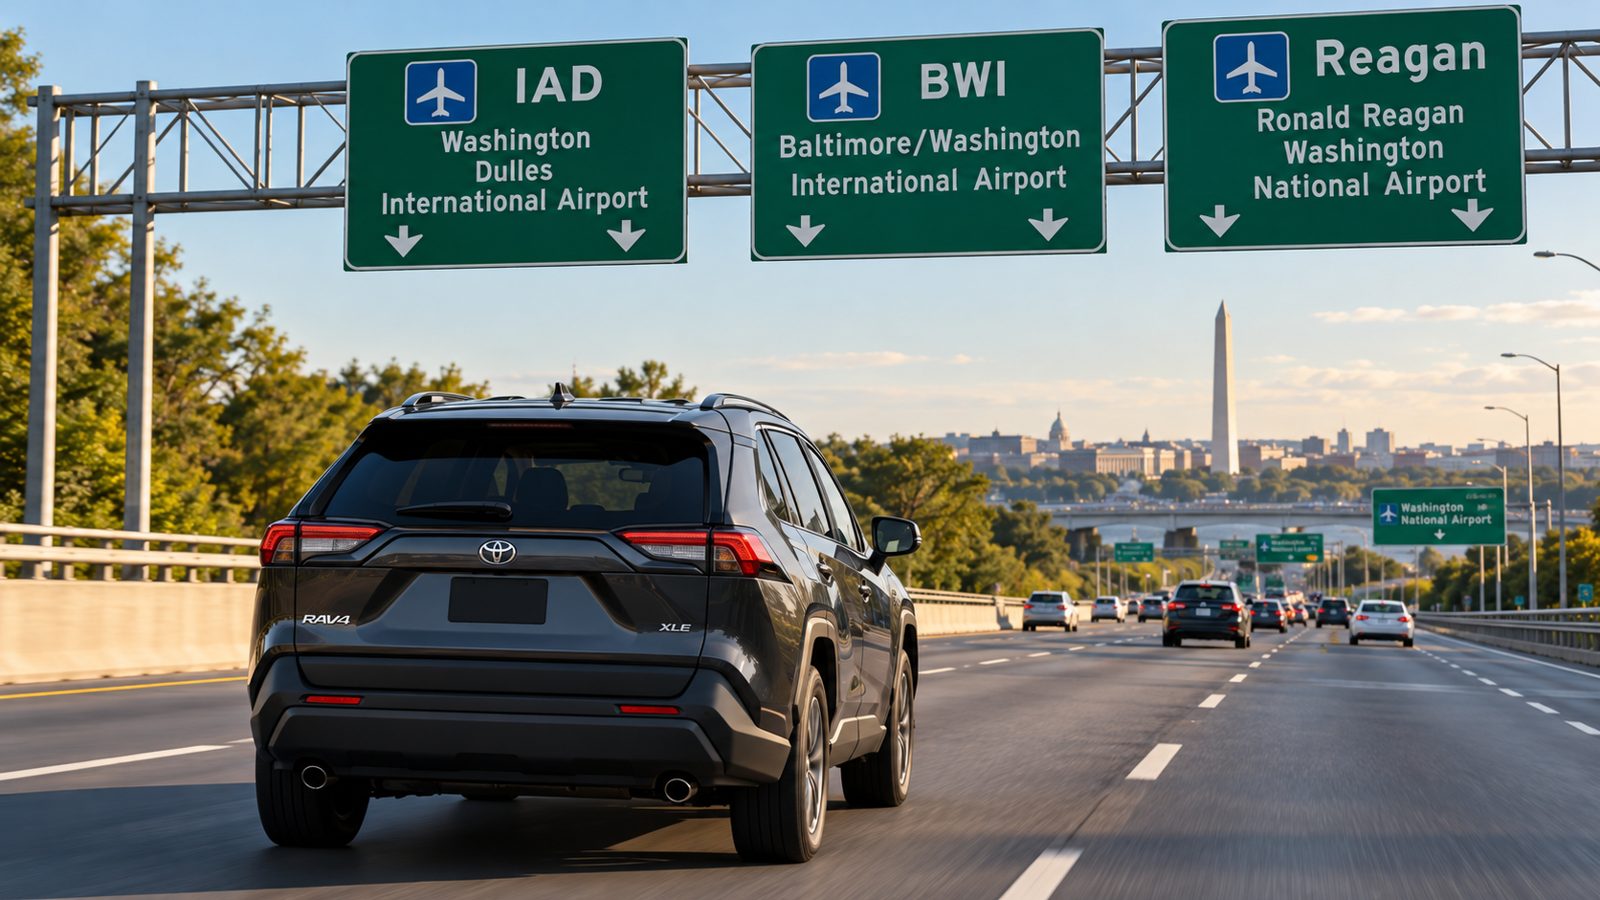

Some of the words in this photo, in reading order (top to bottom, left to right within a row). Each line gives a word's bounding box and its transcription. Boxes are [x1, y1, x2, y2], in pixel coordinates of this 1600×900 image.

[1316, 39, 1486, 83] Reagan
[516, 64, 603, 104] IAD
[921, 60, 1006, 100] BWI
[1257, 104, 1350, 132] Ronald
[1363, 103, 1464, 132] Reagan
[441, 127, 591, 156] Washington
[780, 125, 1081, 159] Baltimore/Washington
[1283, 136, 1444, 167] Washington
[476, 159, 553, 183] Dulles
[792, 168, 958, 196] International
[973, 165, 1067, 195] Airport
[1254, 172, 1369, 200] National
[1384, 168, 1487, 200] Airport
[382, 188, 546, 215] International
[557, 186, 648, 215] Airport
[1401, 502, 1464, 515] Washington
[1401, 514, 1447, 525] National
[1451, 514, 1492, 527] Airport
[301, 614, 351, 625] RAV4
[659, 623, 692, 632] XLE
